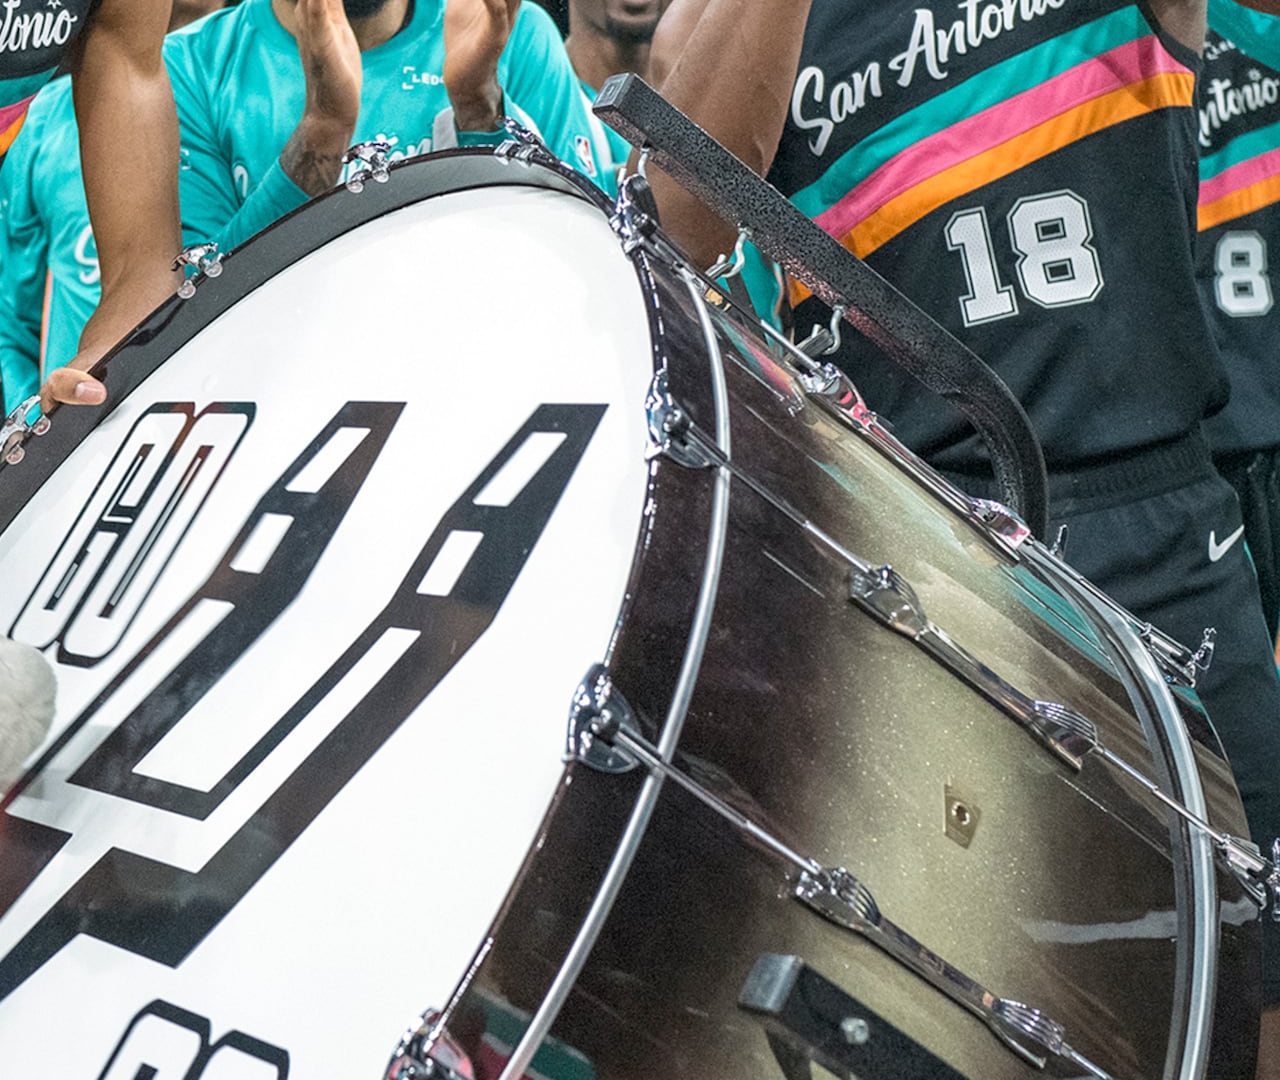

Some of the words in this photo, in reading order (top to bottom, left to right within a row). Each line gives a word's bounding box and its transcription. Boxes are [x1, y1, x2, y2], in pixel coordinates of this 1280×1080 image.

[791, 62, 882, 157] San
[1198, 69, 1280, 148] ntonio
[943, 188, 1105, 328] 18
[1214, 229, 1274, 318] 8
